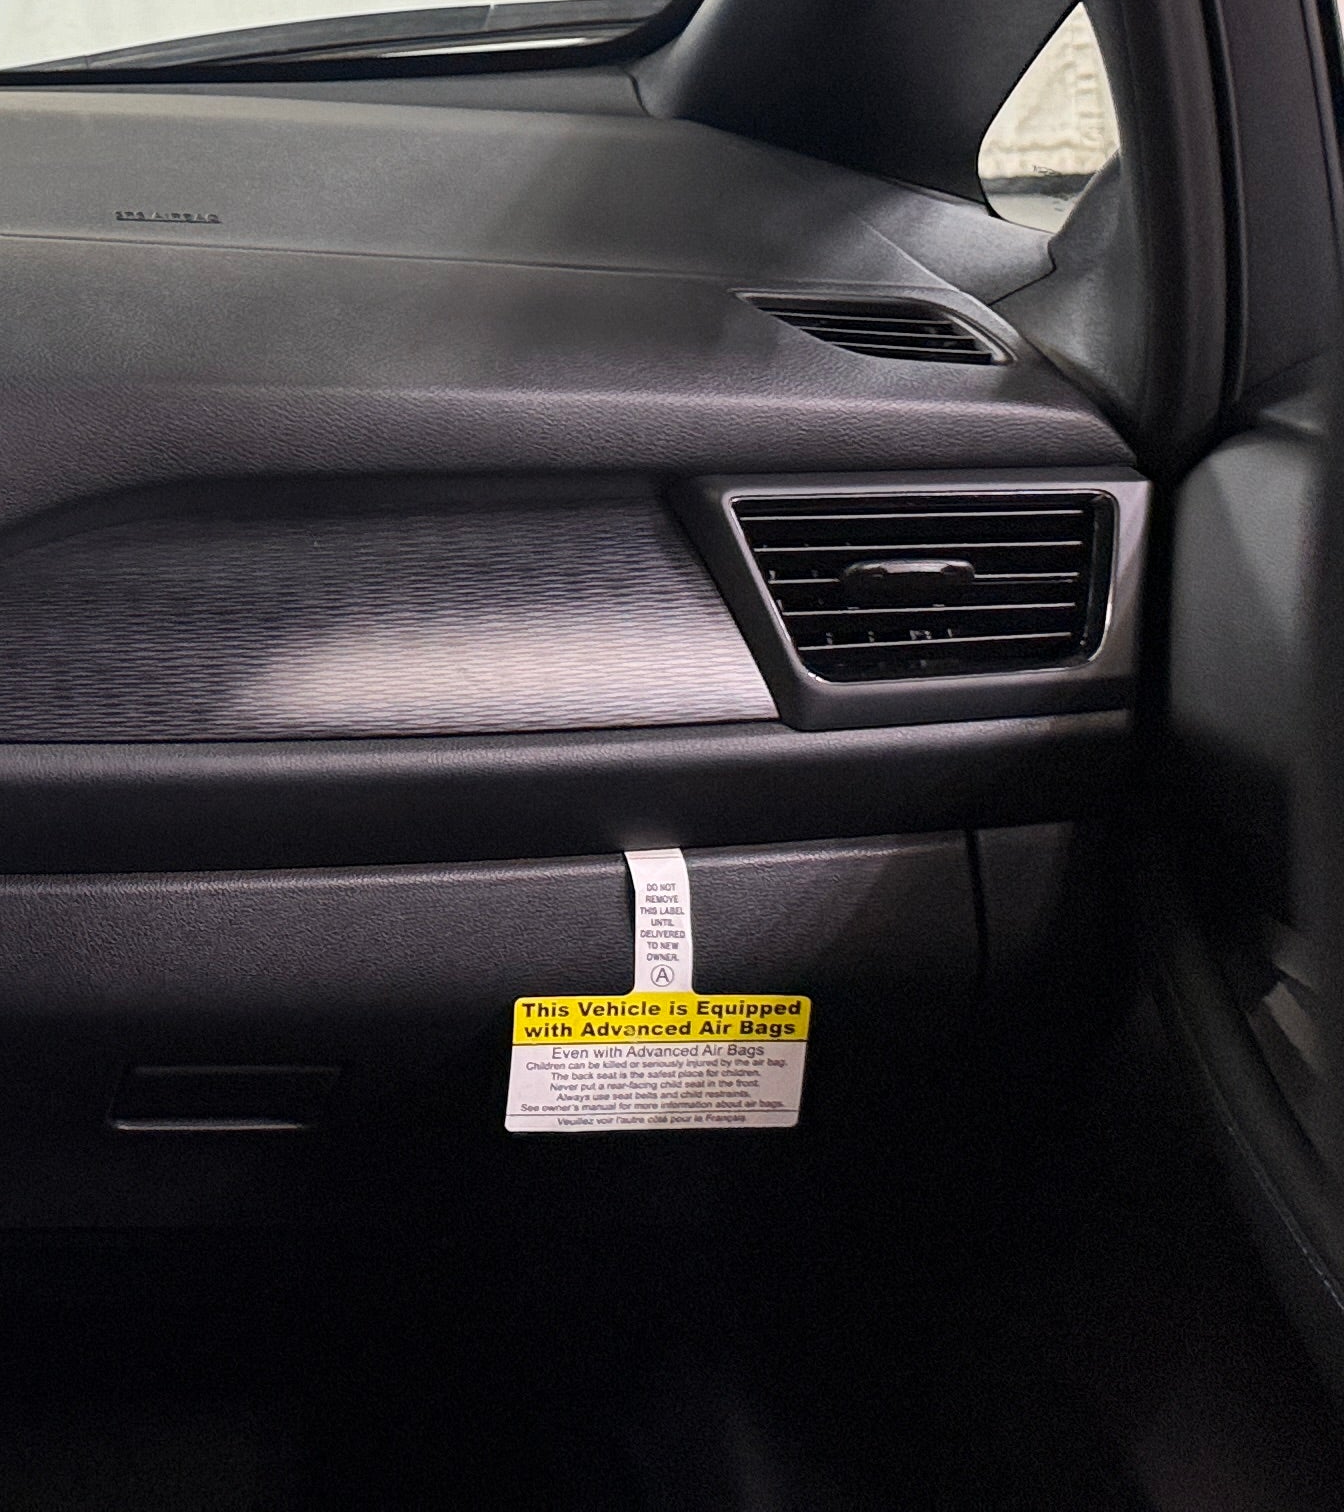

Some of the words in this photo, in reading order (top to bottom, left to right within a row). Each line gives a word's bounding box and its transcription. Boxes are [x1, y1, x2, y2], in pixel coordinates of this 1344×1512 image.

[646, 883, 658, 892] DO
[660, 883, 676, 892] NOT
[645, 894, 679, 904] REMOVE
[640, 906, 658, 915] THIS
[660, 906, 685, 915] LABEL
[651, 918, 675, 927] UNTIL
[640, 929, 686, 939] DELIVERED
[647, 941, 658, 950] TO
[660, 941, 679, 950] NEW
[522, 1002, 570, 1018] This
[577, 1001, 662, 1017] Vehicle
[669, 1000, 688, 1016] is
[696, 999, 802, 1019] Equipped
[524, 1022, 573, 1038] with
[581, 1021, 692, 1037] Advanced
[698, 1019, 732, 1035] Air
[739, 1019, 796, 1038] Bags
[552, 1046, 589, 1060] Even
[592, 1046, 623, 1059] with
[626, 1045, 699, 1058] Advanced
[702, 1044, 724, 1057] Air
[727, 1043, 765, 1060] Bags
[525, 1060, 566, 1071] Children
[568, 1062, 586, 1070] can
[588, 1061, 600, 1070] be
[629, 1061, 640, 1069] or
[720, 1059, 733, 1069] by
[734, 1058, 750, 1068] the
[752, 1058, 765, 1067] air
[552, 1071, 570, 1081] The
[571, 1071, 594, 1080] back
[619, 1071, 627, 1080] is
[629, 1071, 645, 1079] the
